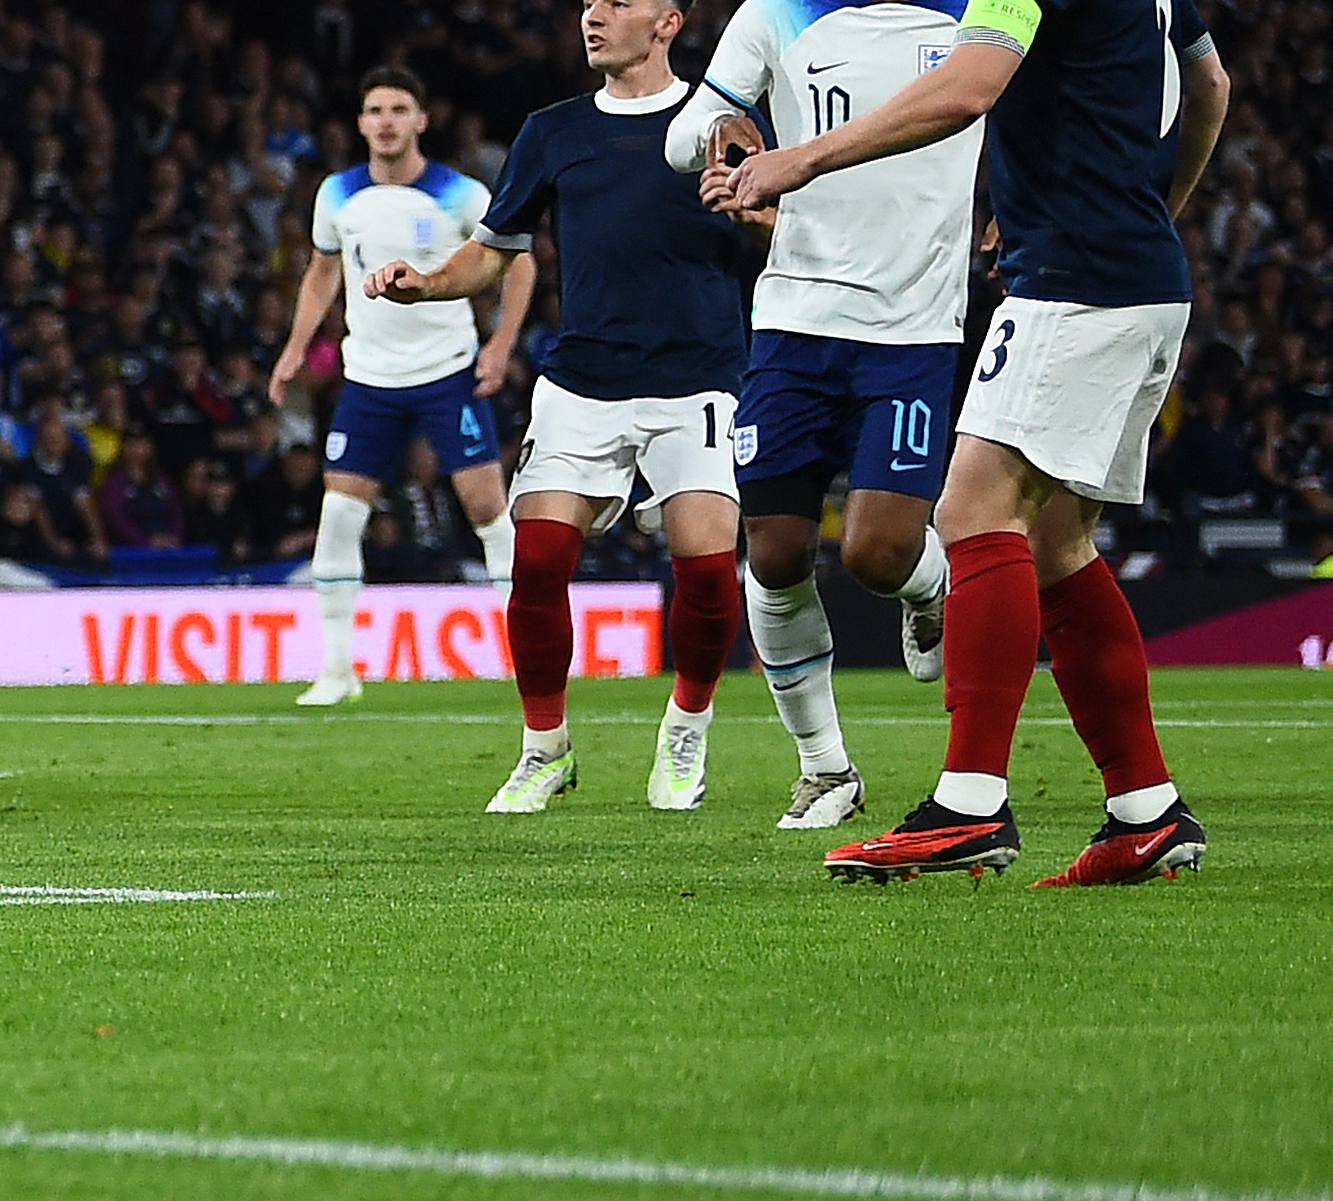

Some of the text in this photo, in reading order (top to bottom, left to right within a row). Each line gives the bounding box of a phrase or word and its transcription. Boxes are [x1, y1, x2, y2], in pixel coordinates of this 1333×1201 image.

[808, 83, 851, 137] 10
[977, 319, 1015, 383] 3
[460, 404, 483, 441] 4
[891, 399, 932, 457] 10
[82, 612, 296, 683] VISIT
